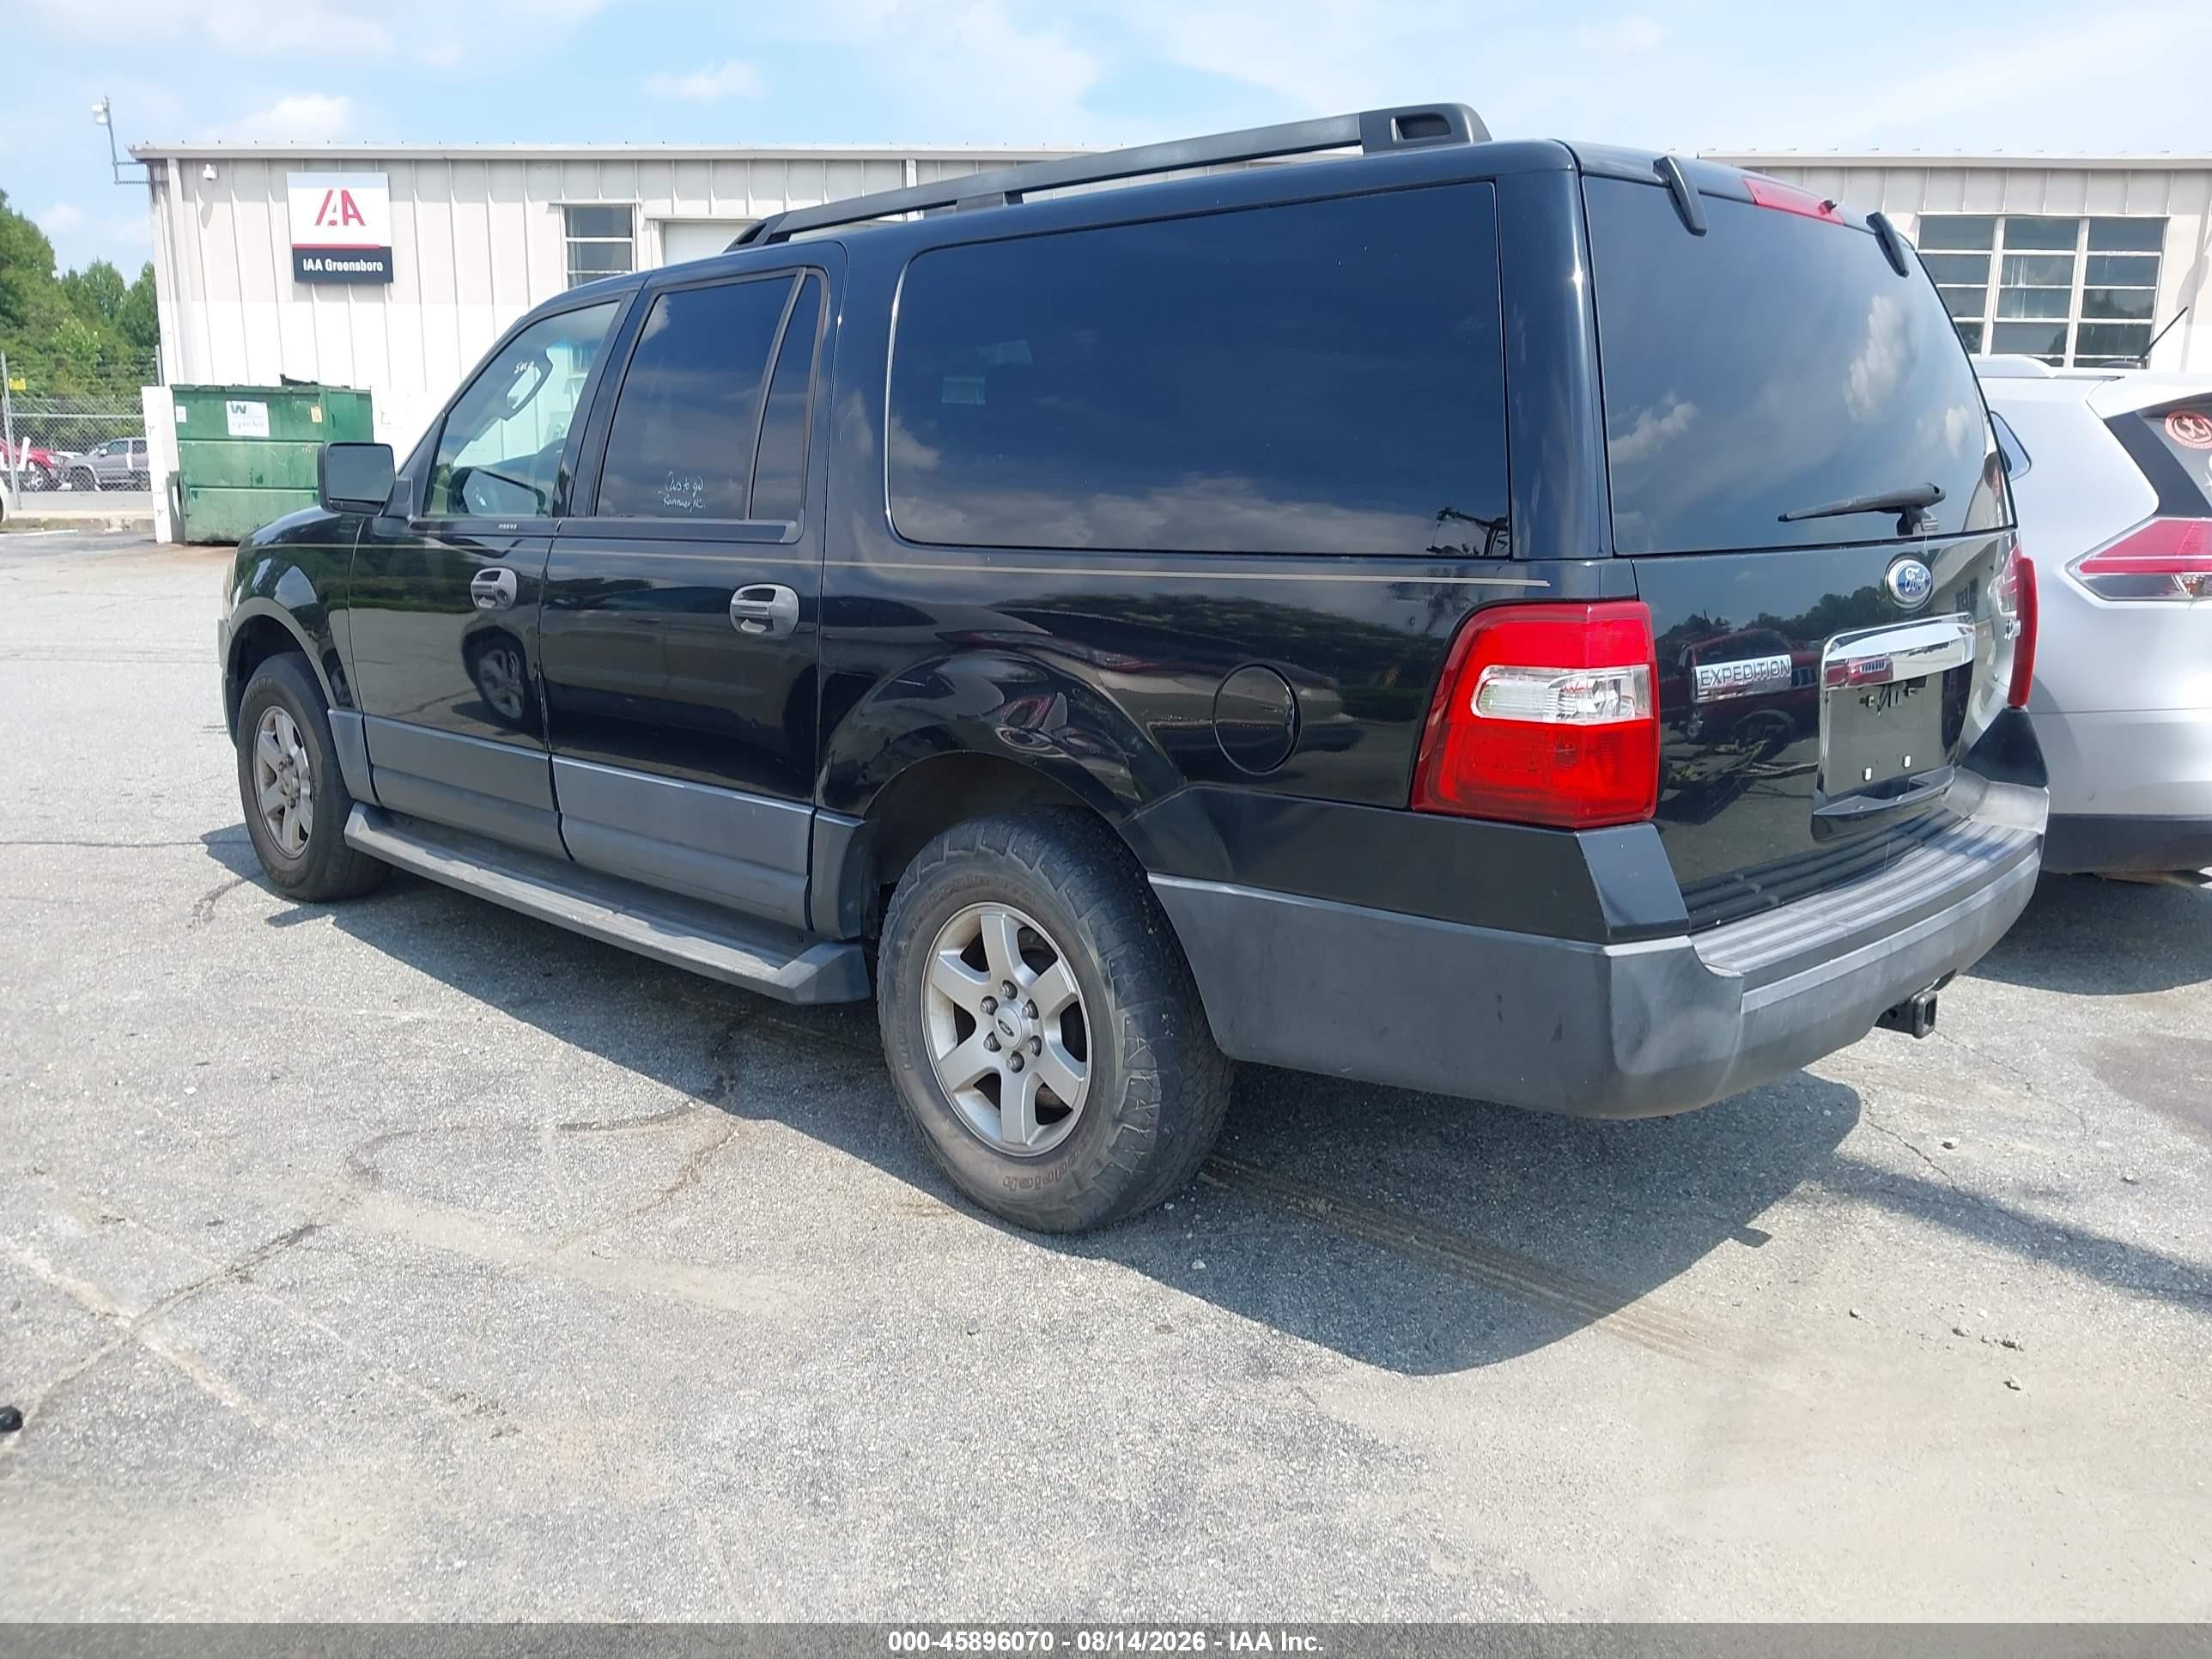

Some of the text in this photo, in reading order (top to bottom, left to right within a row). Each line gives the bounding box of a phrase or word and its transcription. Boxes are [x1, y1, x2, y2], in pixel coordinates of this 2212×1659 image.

[302, 258, 385, 273] IAA Greensboro
[1904, 567, 1926, 593] Ford
[1699, 658, 1791, 686] EXPEDITION
